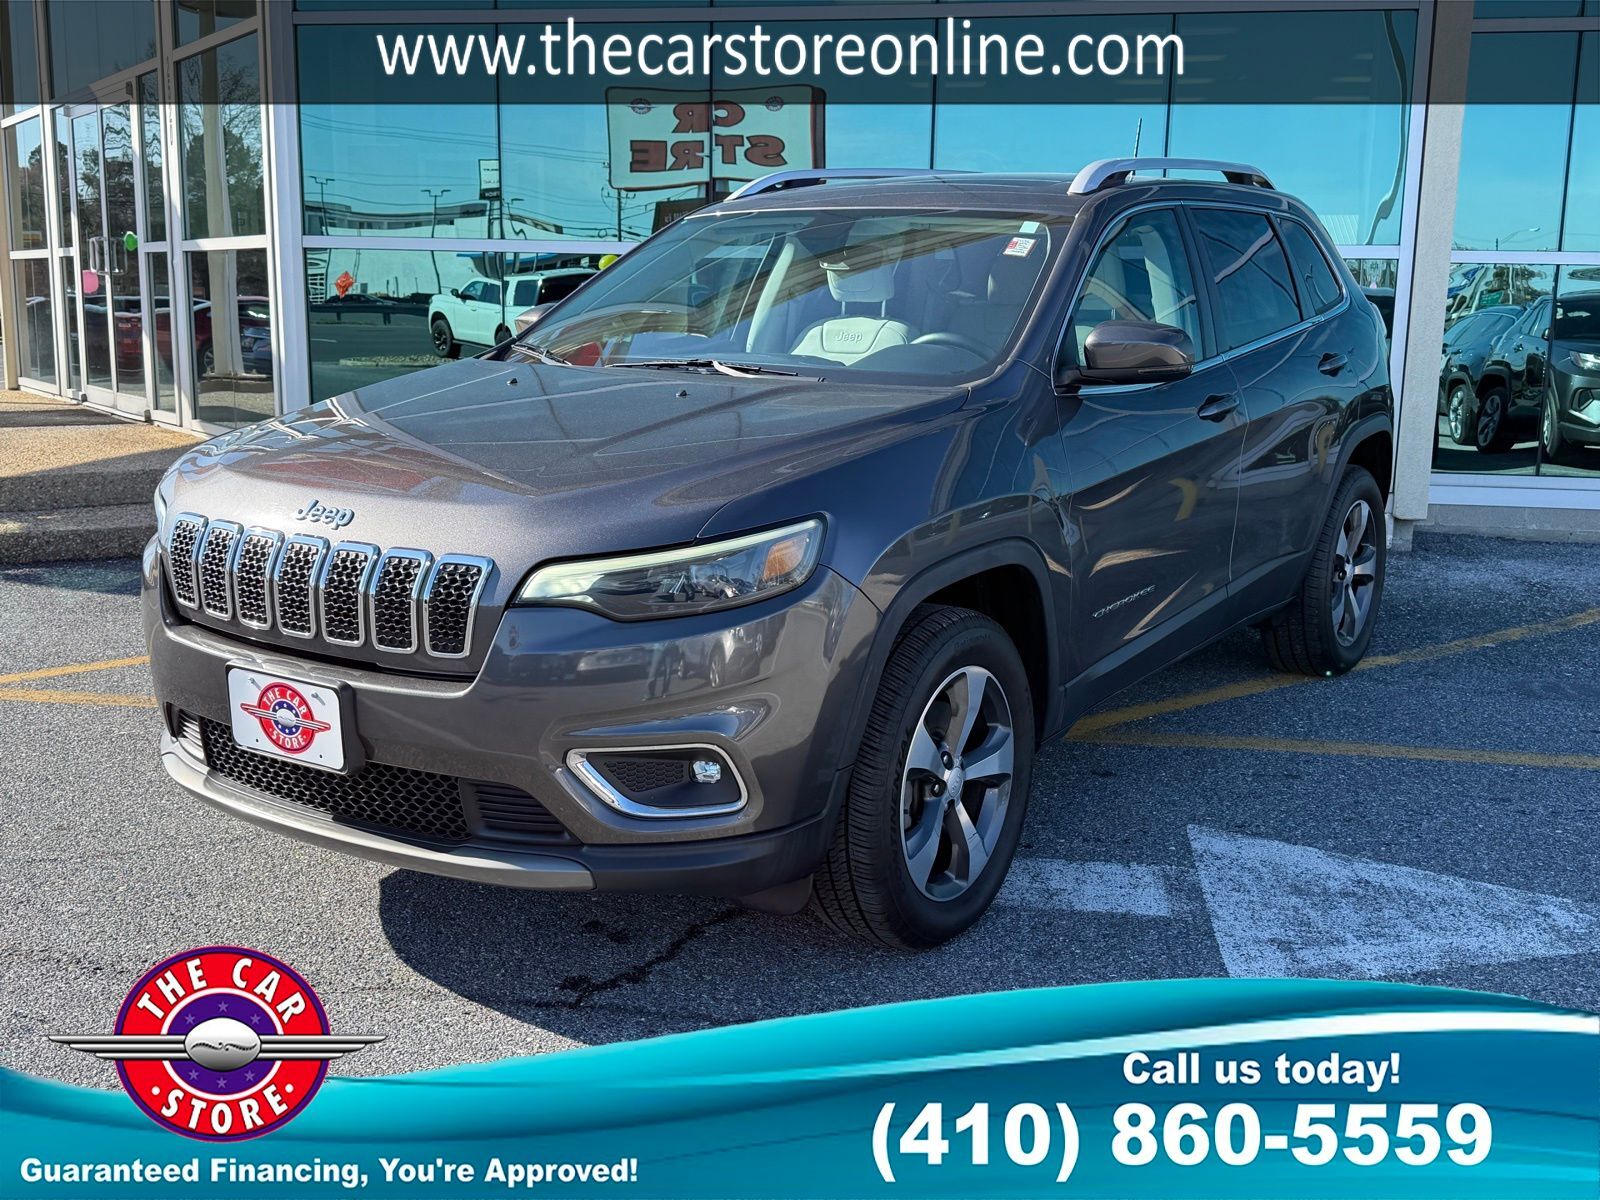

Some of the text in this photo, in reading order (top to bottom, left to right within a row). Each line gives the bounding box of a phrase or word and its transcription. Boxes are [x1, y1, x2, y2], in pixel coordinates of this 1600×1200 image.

[836, 330, 863, 342] Jeep
[295, 499, 355, 530] Jeep
[263, 687, 307, 715] THE CAR
[271, 731, 305, 749] STORE
